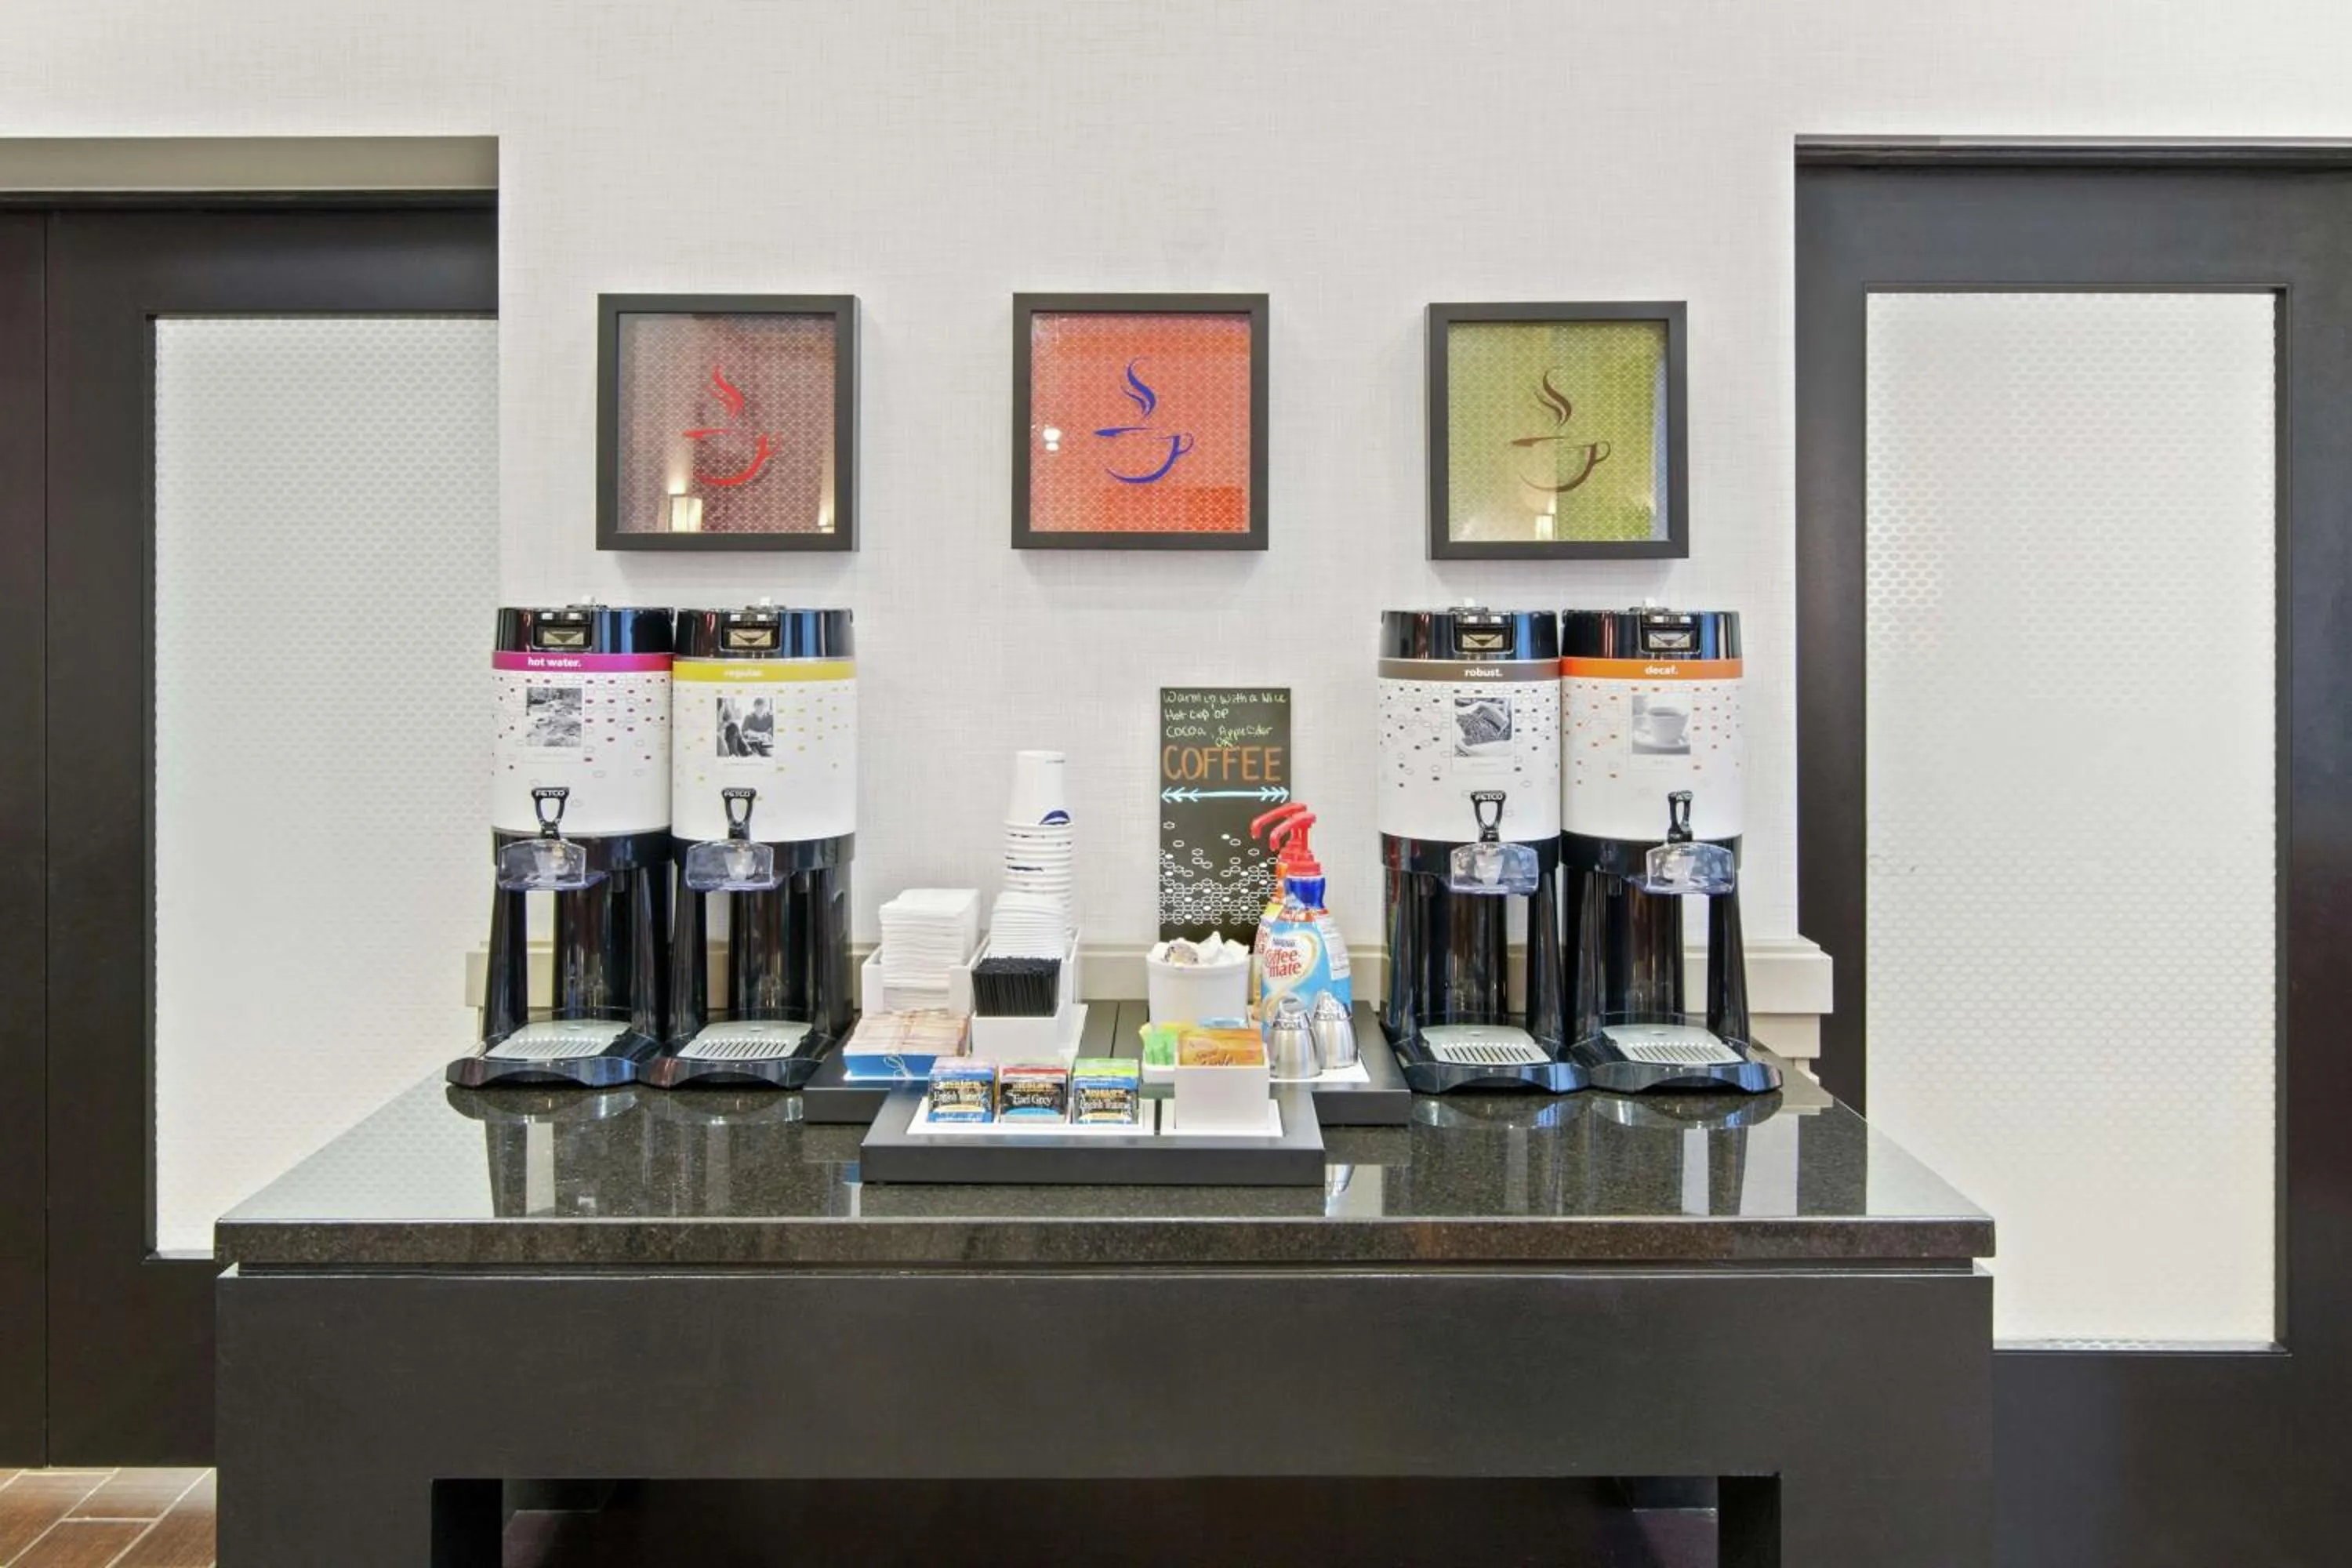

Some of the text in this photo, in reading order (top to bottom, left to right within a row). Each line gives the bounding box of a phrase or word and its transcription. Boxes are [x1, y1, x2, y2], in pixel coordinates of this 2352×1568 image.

[527, 657, 581, 667] hot water.
[1465, 667, 1503, 677] robust.
[1645, 665, 1678, 675] decaf.
[1163, 745, 1283, 782] COFFEE
